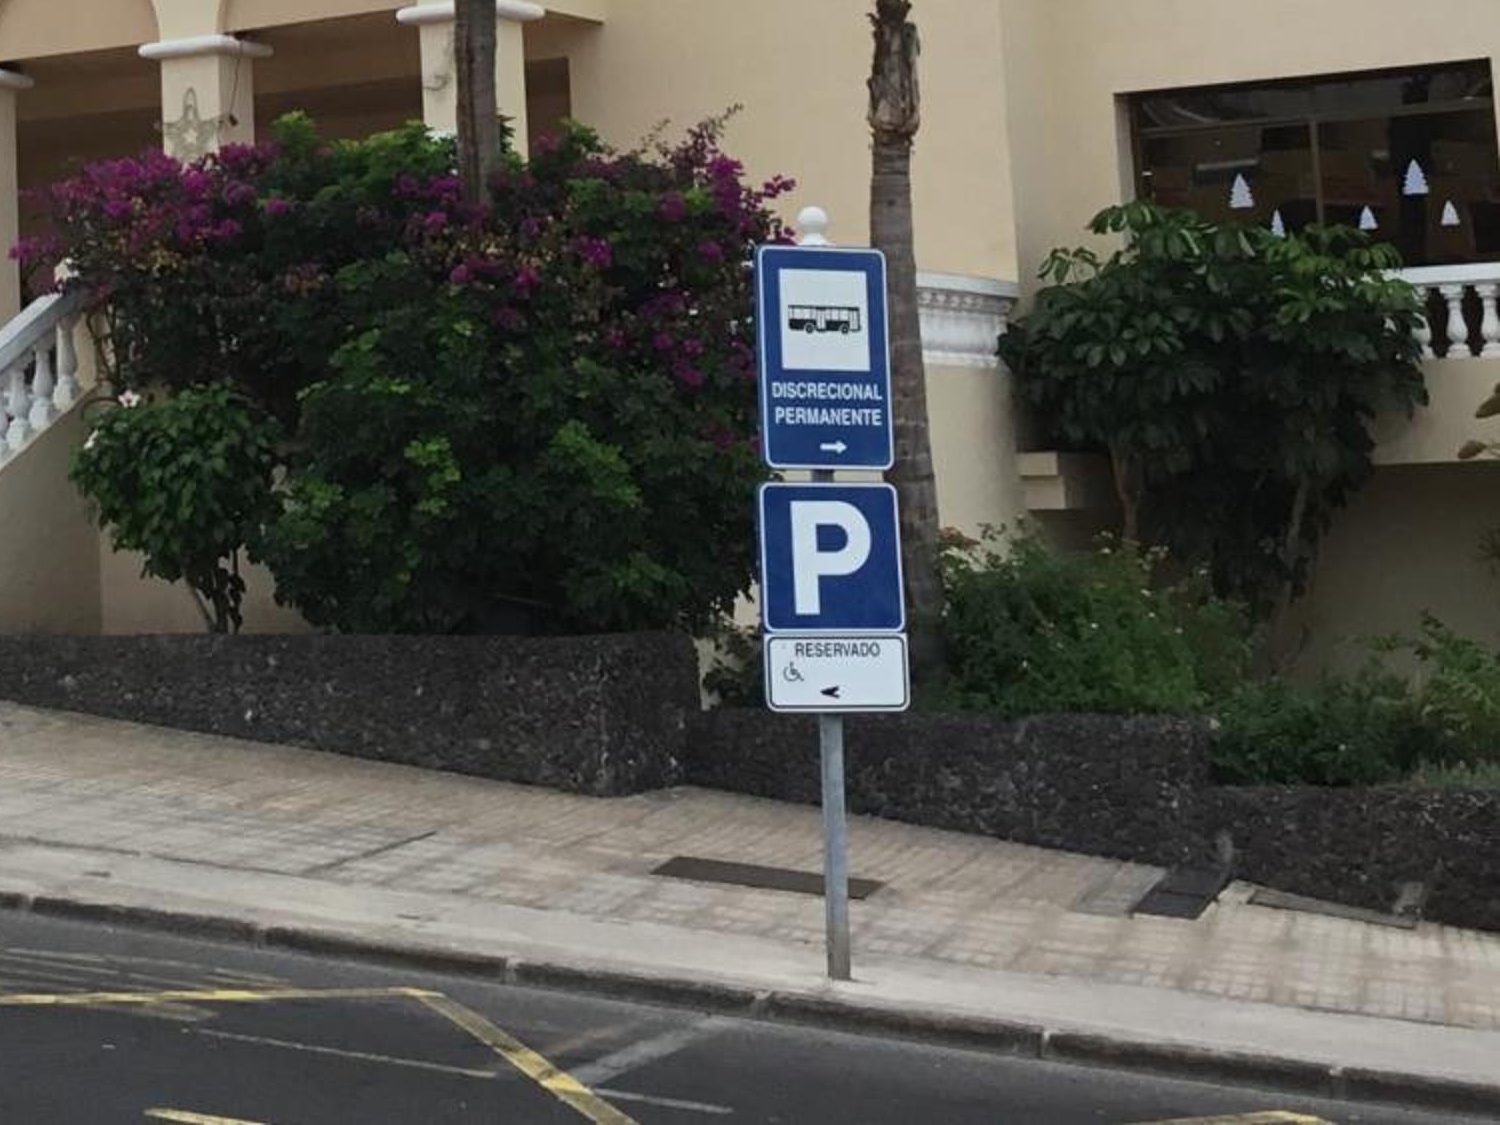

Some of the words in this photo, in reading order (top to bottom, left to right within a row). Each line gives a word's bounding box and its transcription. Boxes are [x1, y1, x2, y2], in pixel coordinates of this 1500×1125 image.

[772, 382, 882, 400] DISCRECIONAL
[775, 406, 882, 425] PERMANENTE
[790, 500, 871, 615] P
[795, 642, 881, 658] RESERVADO
